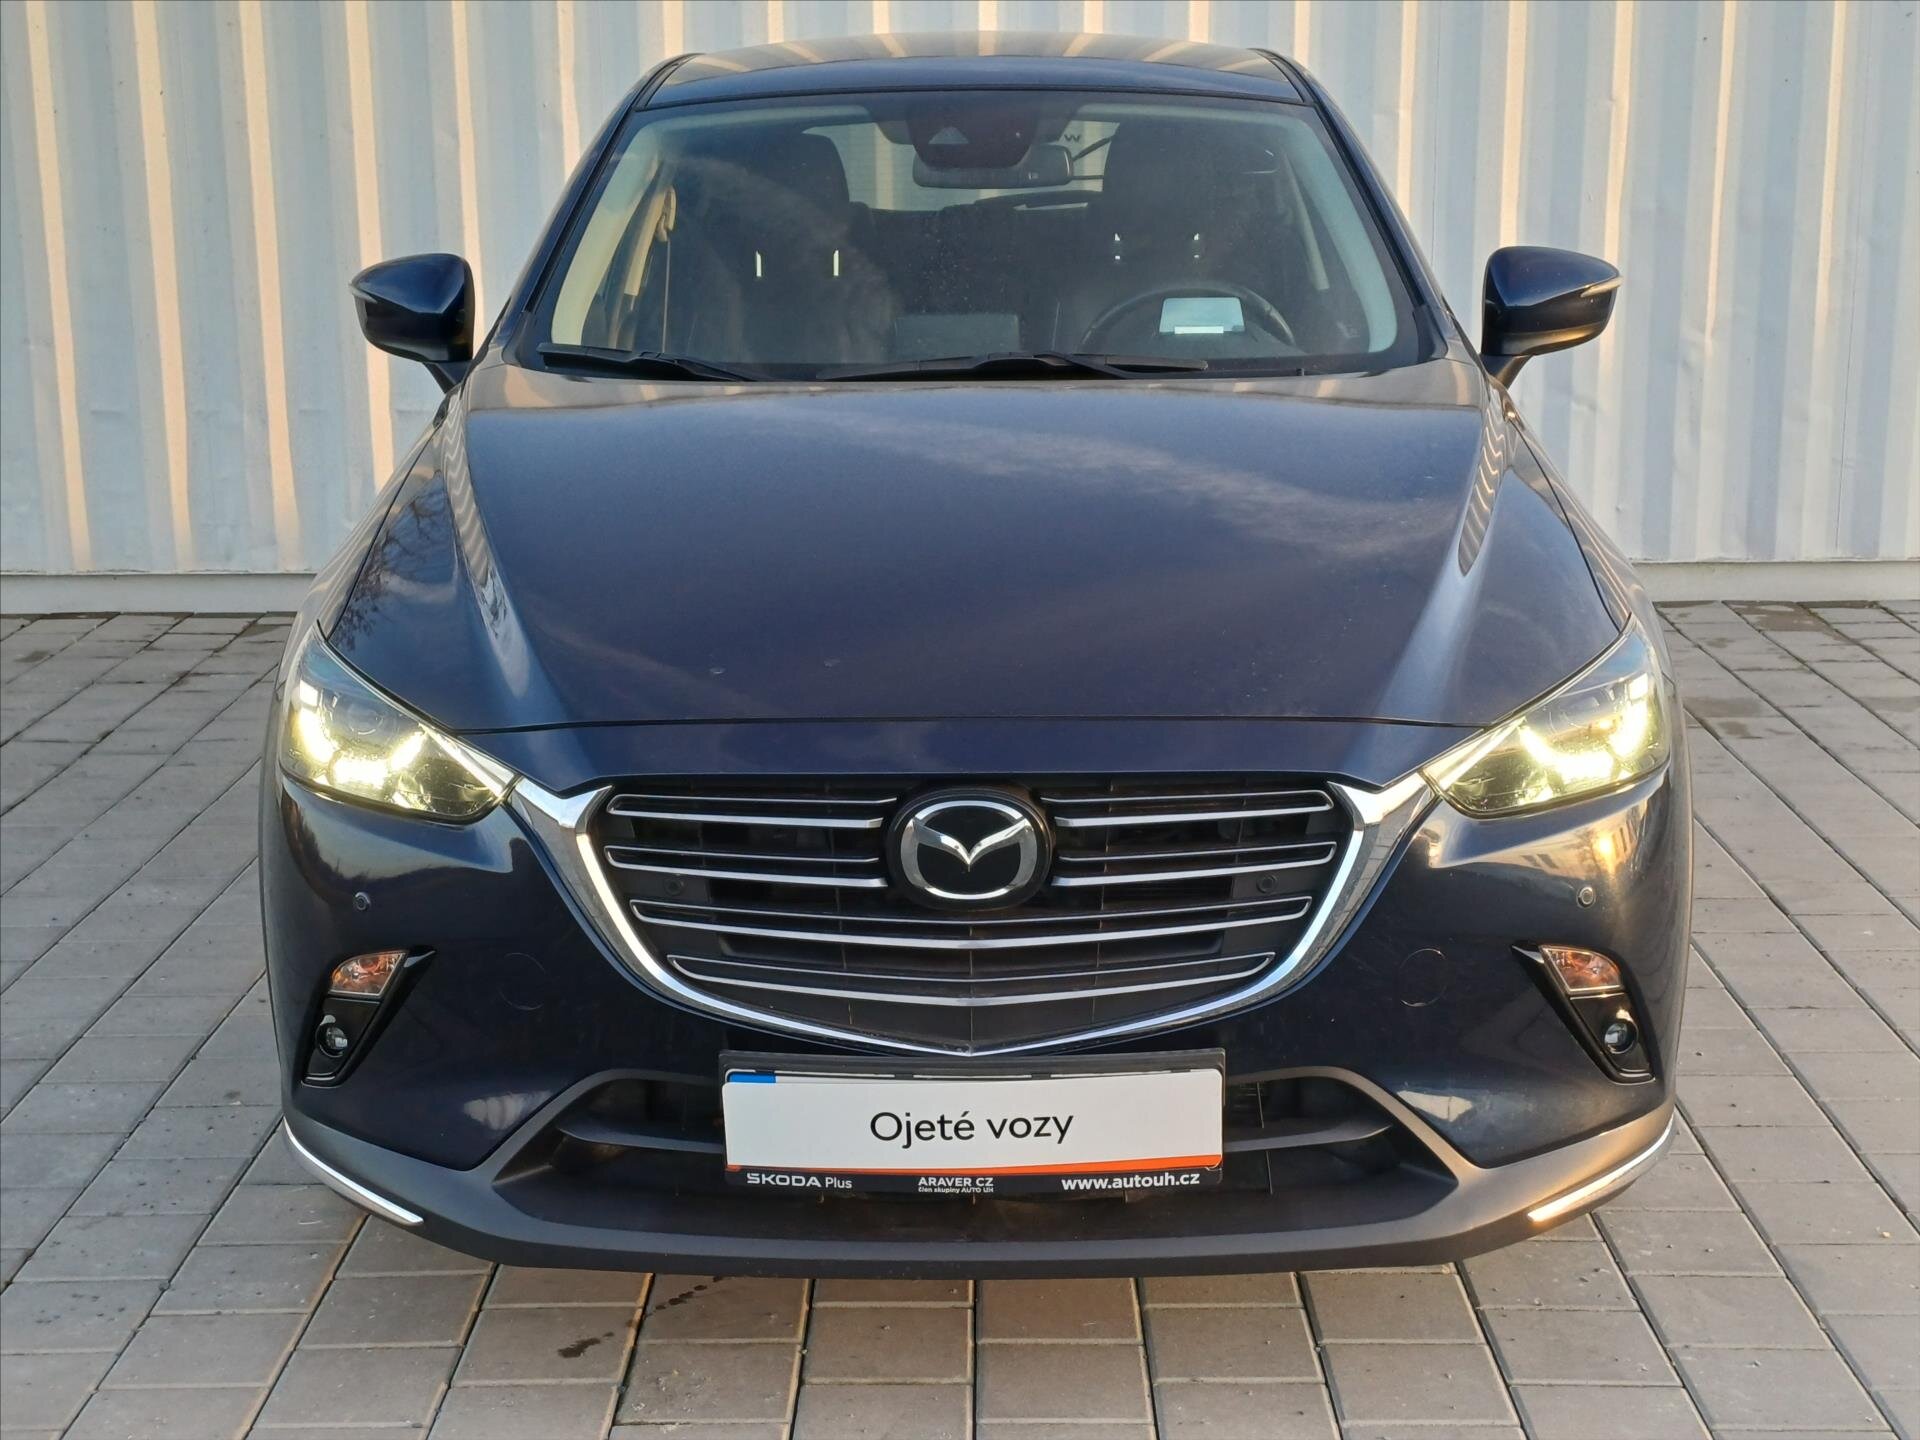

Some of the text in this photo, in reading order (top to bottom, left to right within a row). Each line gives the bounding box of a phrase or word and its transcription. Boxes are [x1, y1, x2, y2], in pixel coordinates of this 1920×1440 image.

[870, 1111, 1074, 1149] Ojeté vozy
[825, 1177, 852, 1189] Plus
[918, 1177, 994, 1187] ARAVER CZ
[1061, 1172, 1200, 1190] www.autouh.cz
